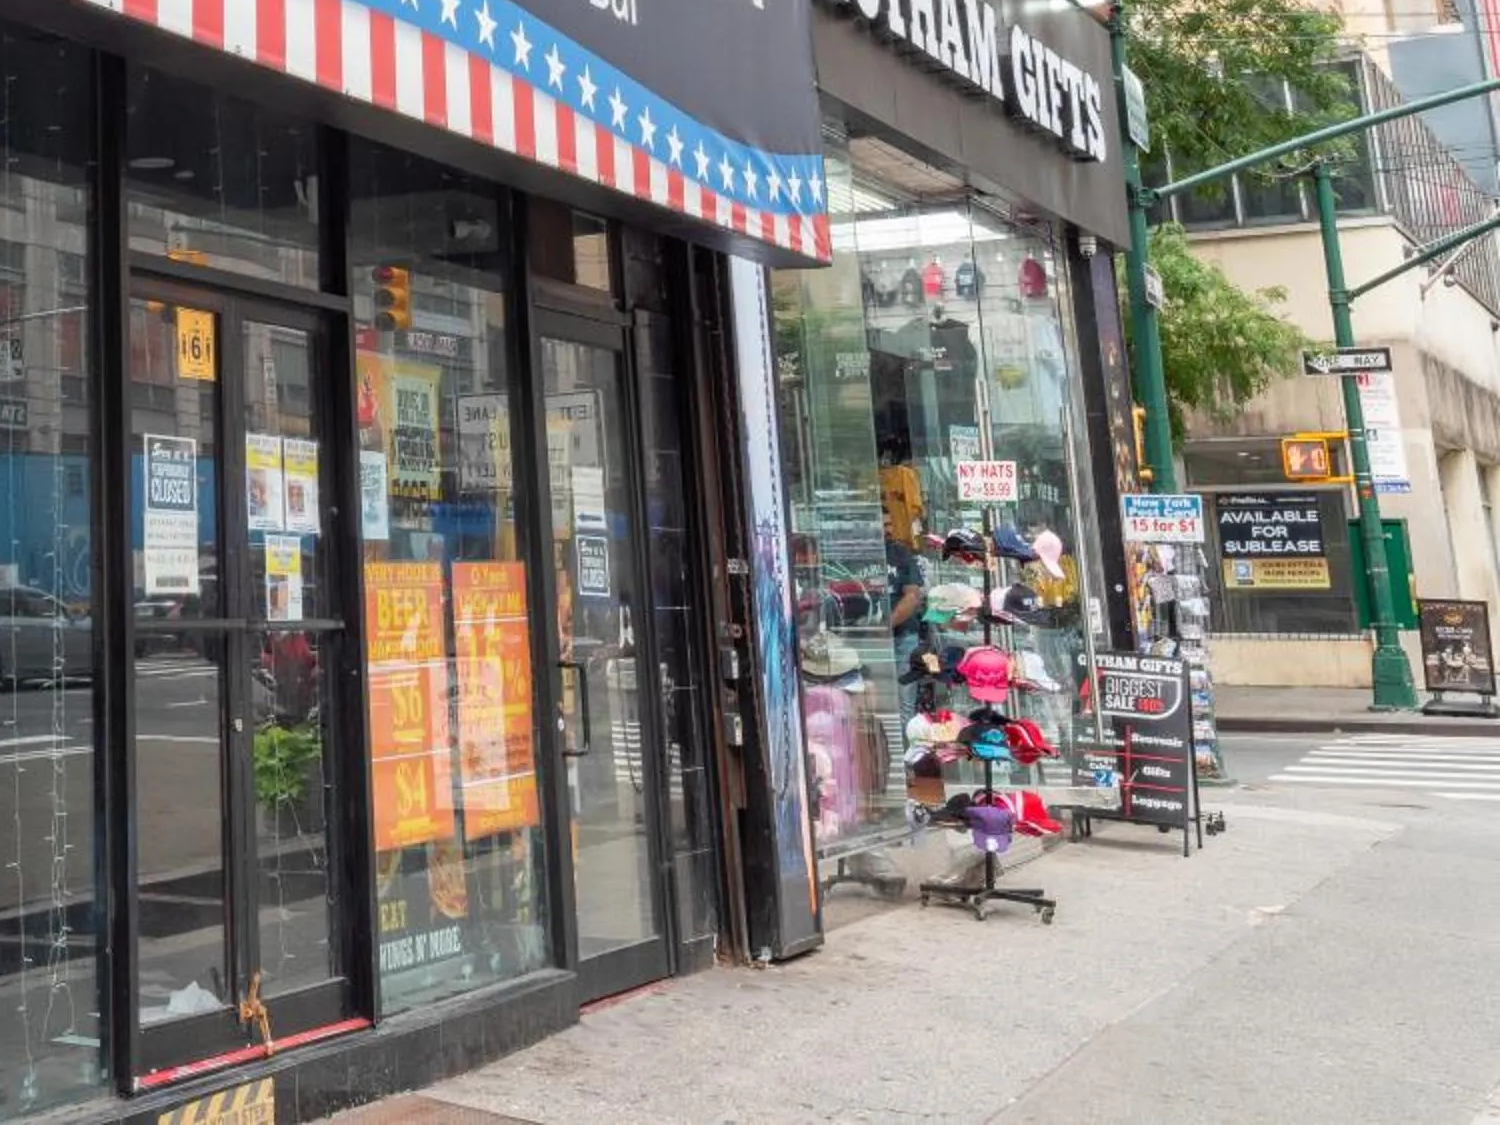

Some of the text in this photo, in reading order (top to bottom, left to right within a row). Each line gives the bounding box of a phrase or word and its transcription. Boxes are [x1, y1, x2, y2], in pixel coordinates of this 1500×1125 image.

[1011, 24, 1107, 164] GIFTS
[191, 336, 201, 360] 6
[1353, 354, 1380, 367] WAY
[959, 463, 1013, 479] NY HATS
[151, 477, 191, 505] CLOSED
[963, 482, 971, 498] 2
[1130, 496, 1192, 508] New York
[1127, 507, 1197, 518] Post Card
[1219, 509, 1320, 524] AVAILABLE
[1131, 518, 1196, 532] 15 for $1
[1251, 524, 1289, 538] FOR
[1224, 539, 1321, 554] SUBLEASE
[377, 587, 429, 630] BEER
[1077, 654, 1184, 674] GTHAM GIFTS
[1105, 676, 1165, 699] BIGGEST
[1105, 694, 1136, 711] SALE
[429, 925, 461, 959] MORE
